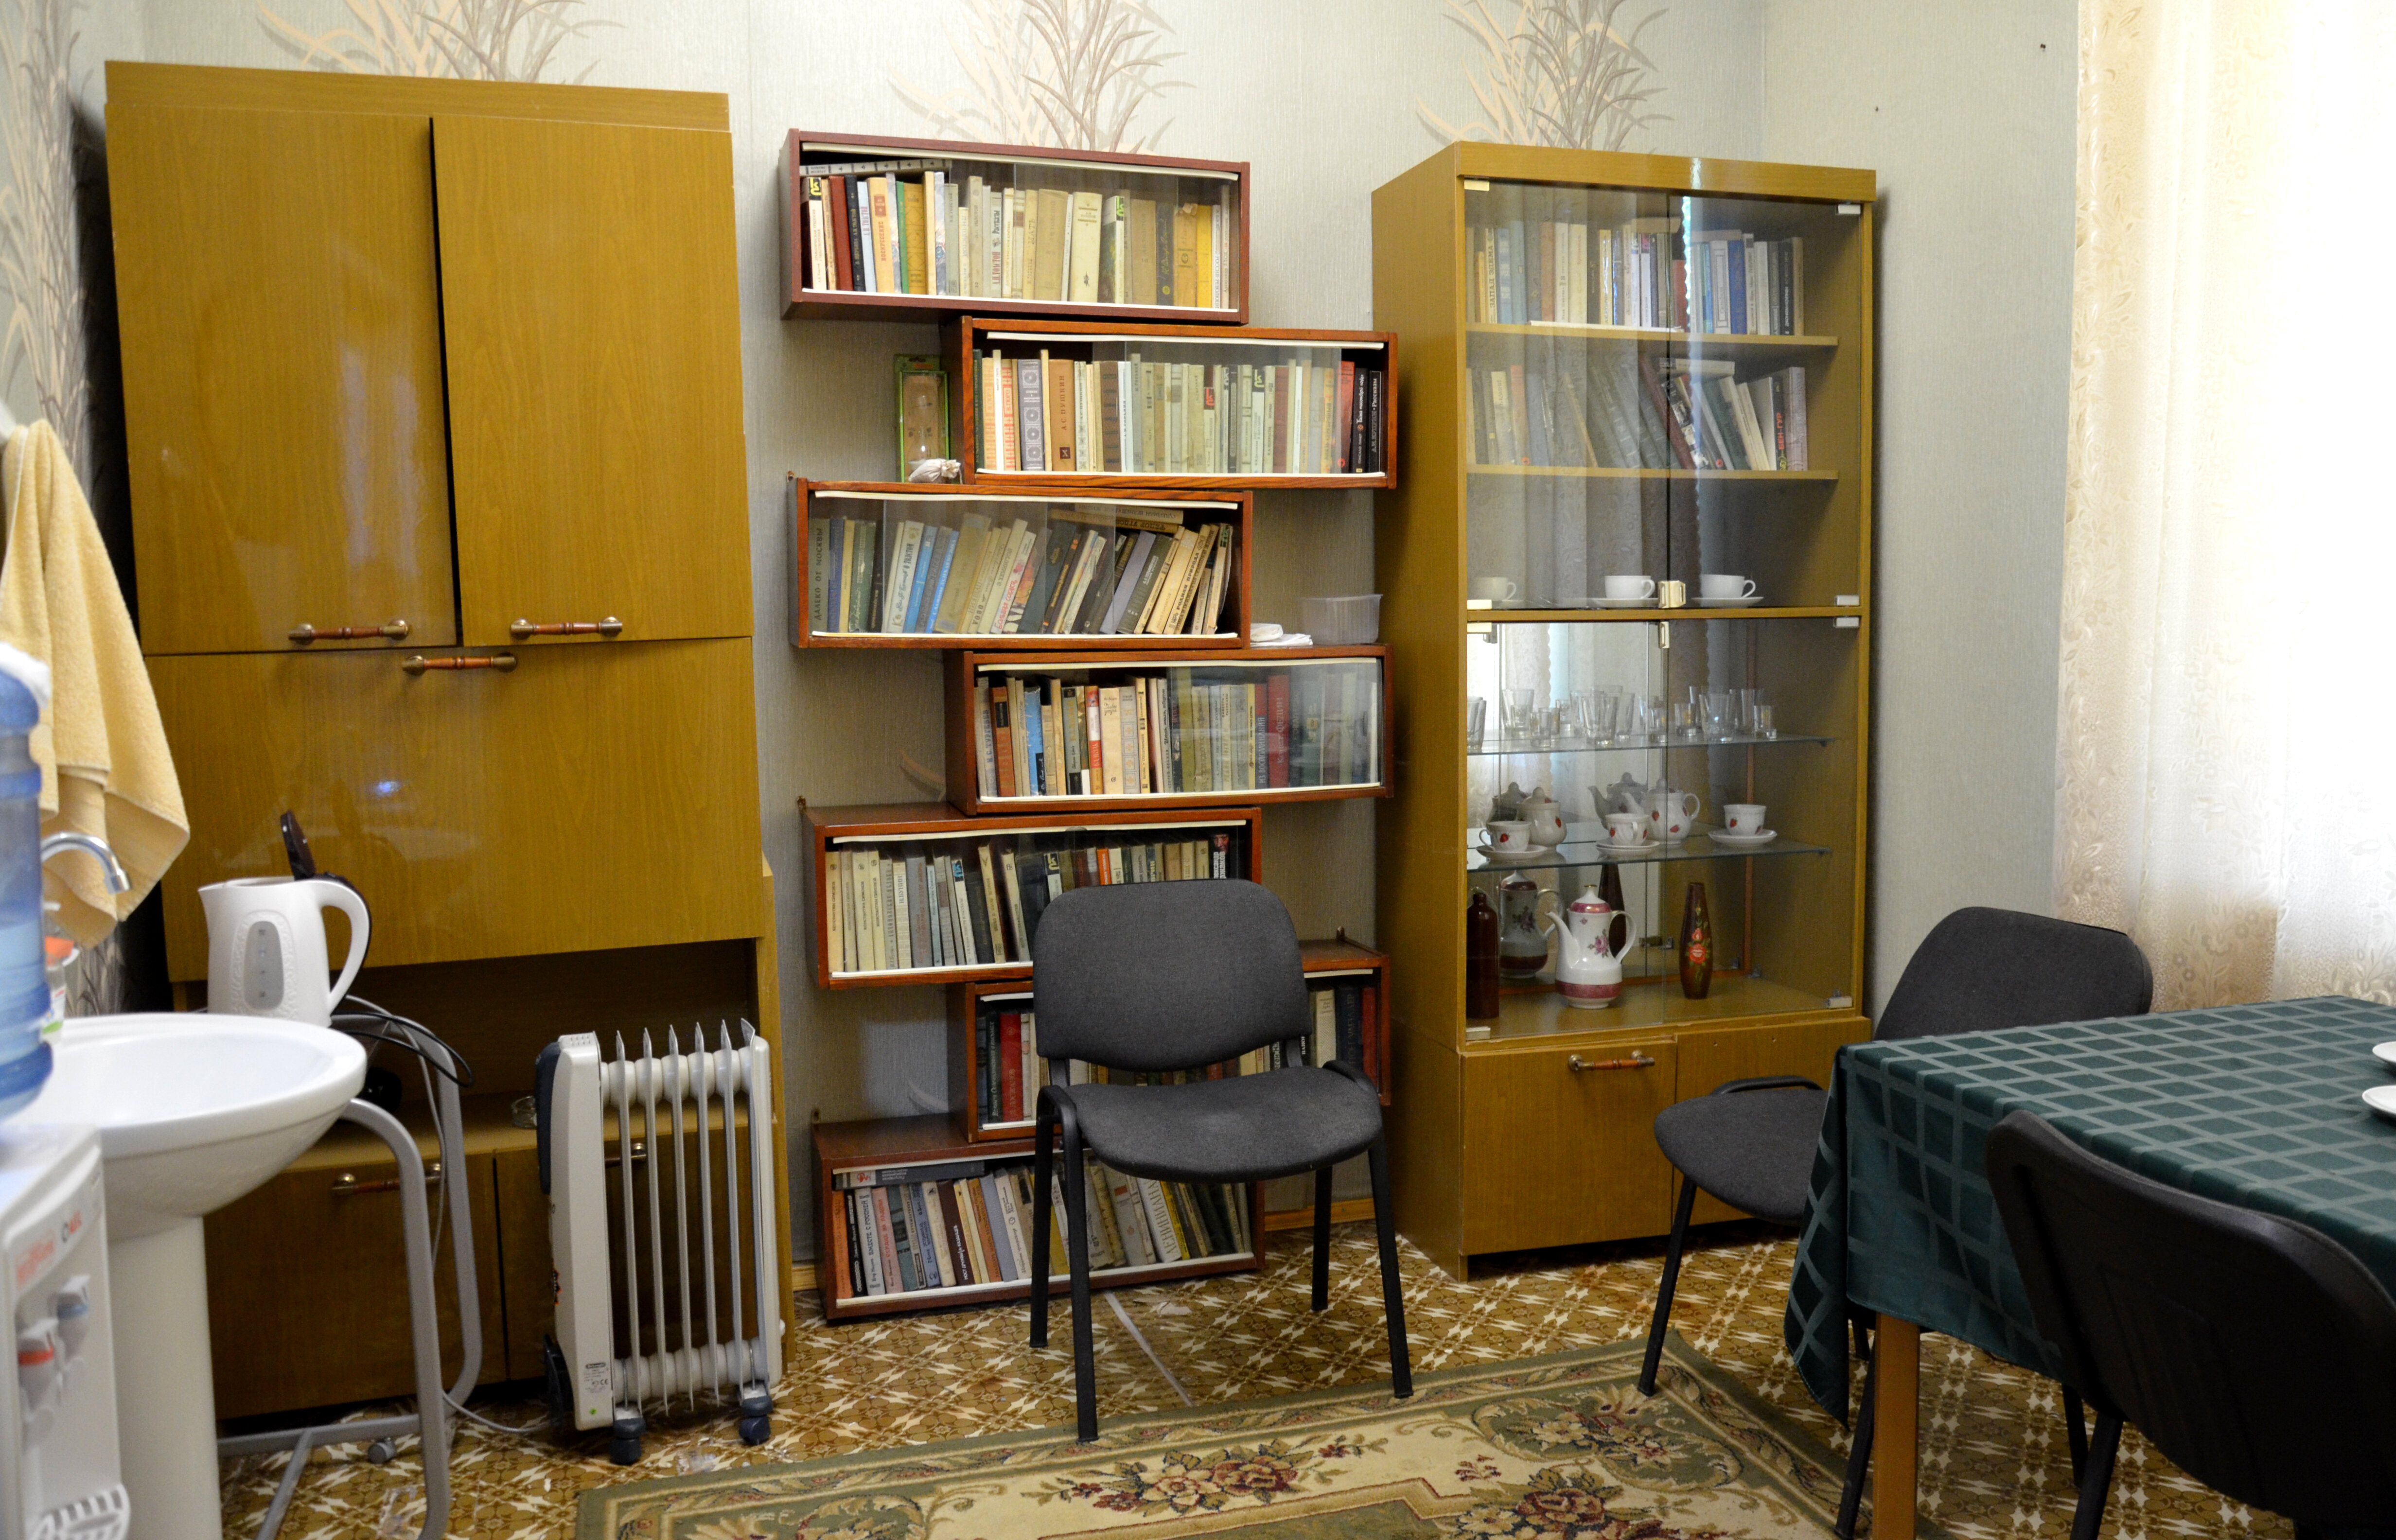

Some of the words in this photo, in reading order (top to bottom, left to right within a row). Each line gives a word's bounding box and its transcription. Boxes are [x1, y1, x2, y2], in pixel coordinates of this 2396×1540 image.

[861, 206, 869, 226] ТОЛСТОЙ
[1776, 412, 1785, 450] БЕН-ГУР
[903, 543, 914, 564] ТОЛСТОМ
[815, 571, 822, 582] ОТ
[1176, 584, 1188, 610] РОДНАЯ
[1186, 552, 1199, 581] ПРИРОДА
[983, 709, 991, 749] ТУРГЕНЕВ
[1257, 775, 1266, 783] ИЗ
[862, 1200, 870, 1225] РОССИЕЙ
[1144, 1180, 1177, 1254] ЛЕНИНИАНА
